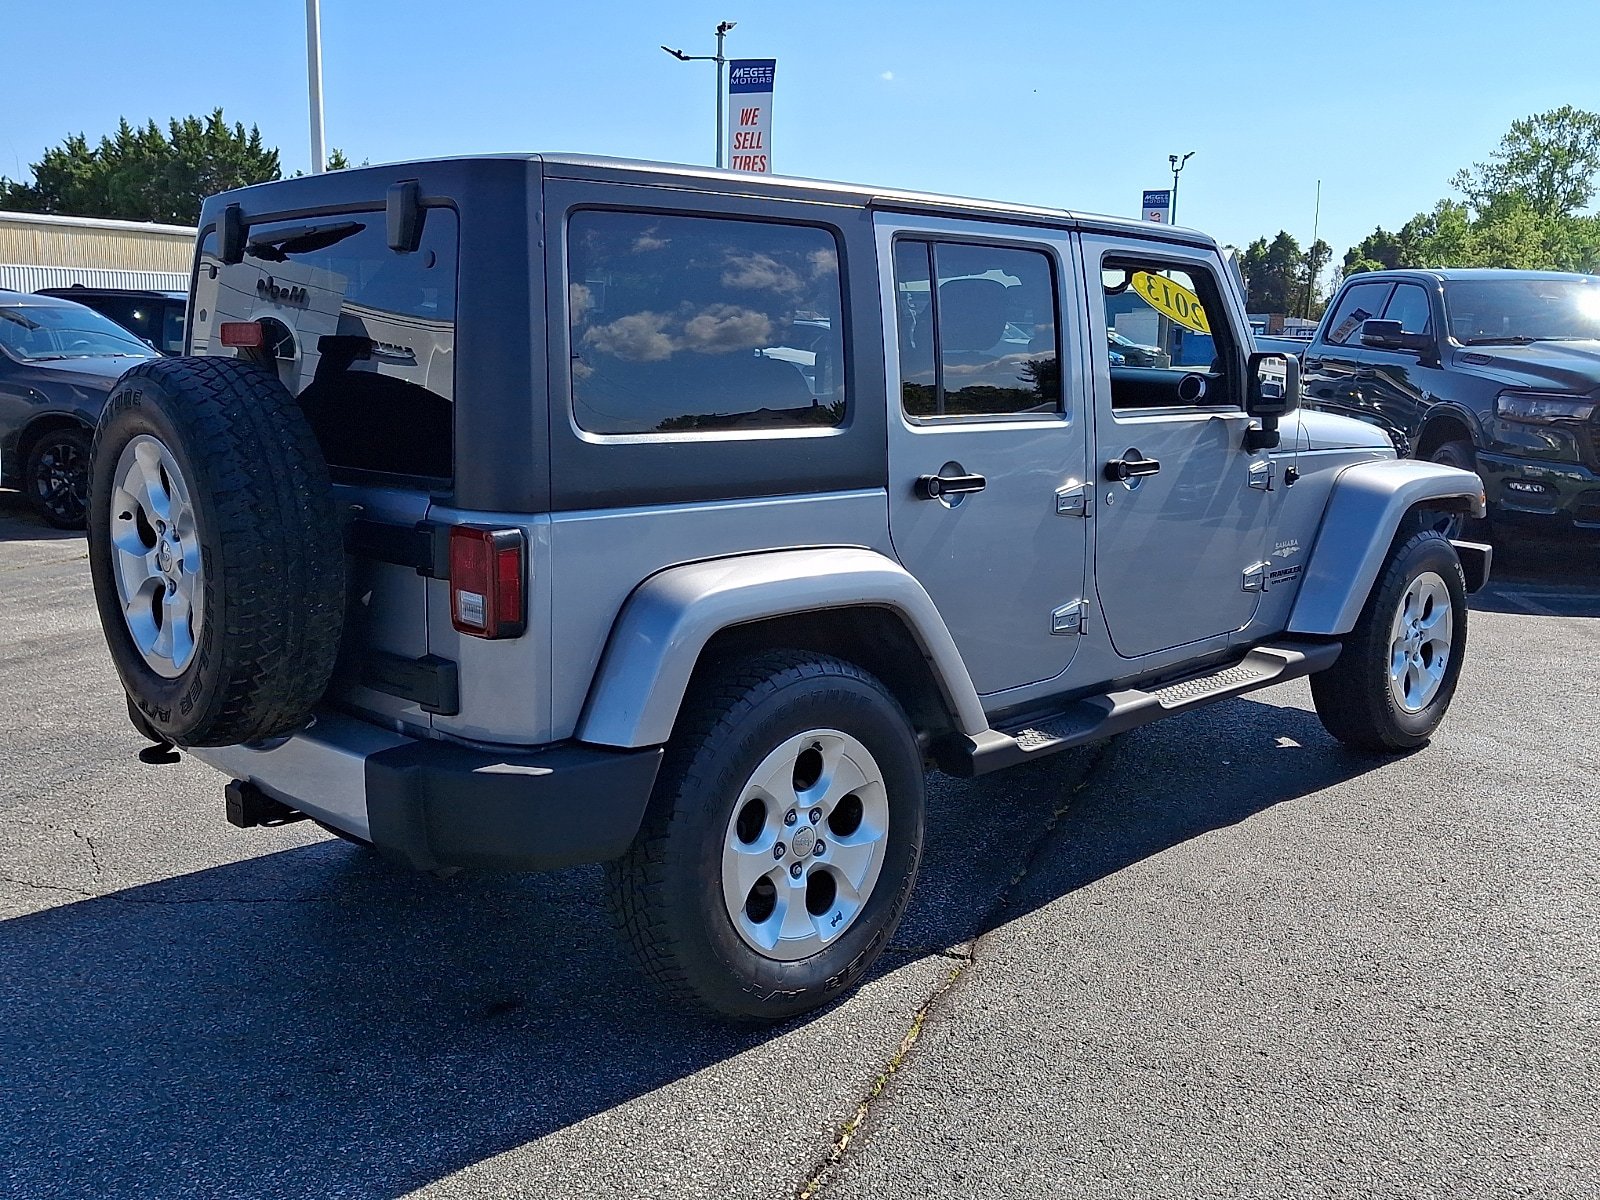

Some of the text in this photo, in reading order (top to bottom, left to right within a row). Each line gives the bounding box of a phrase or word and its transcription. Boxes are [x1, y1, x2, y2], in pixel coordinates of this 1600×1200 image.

[731, 67, 772, 77] MEGEE
[740, 108, 759, 126] WE
[733, 131, 762, 150] SELL
[732, 155, 767, 172] TIRES
[1275, 539, 1298, 549] SAHARA
